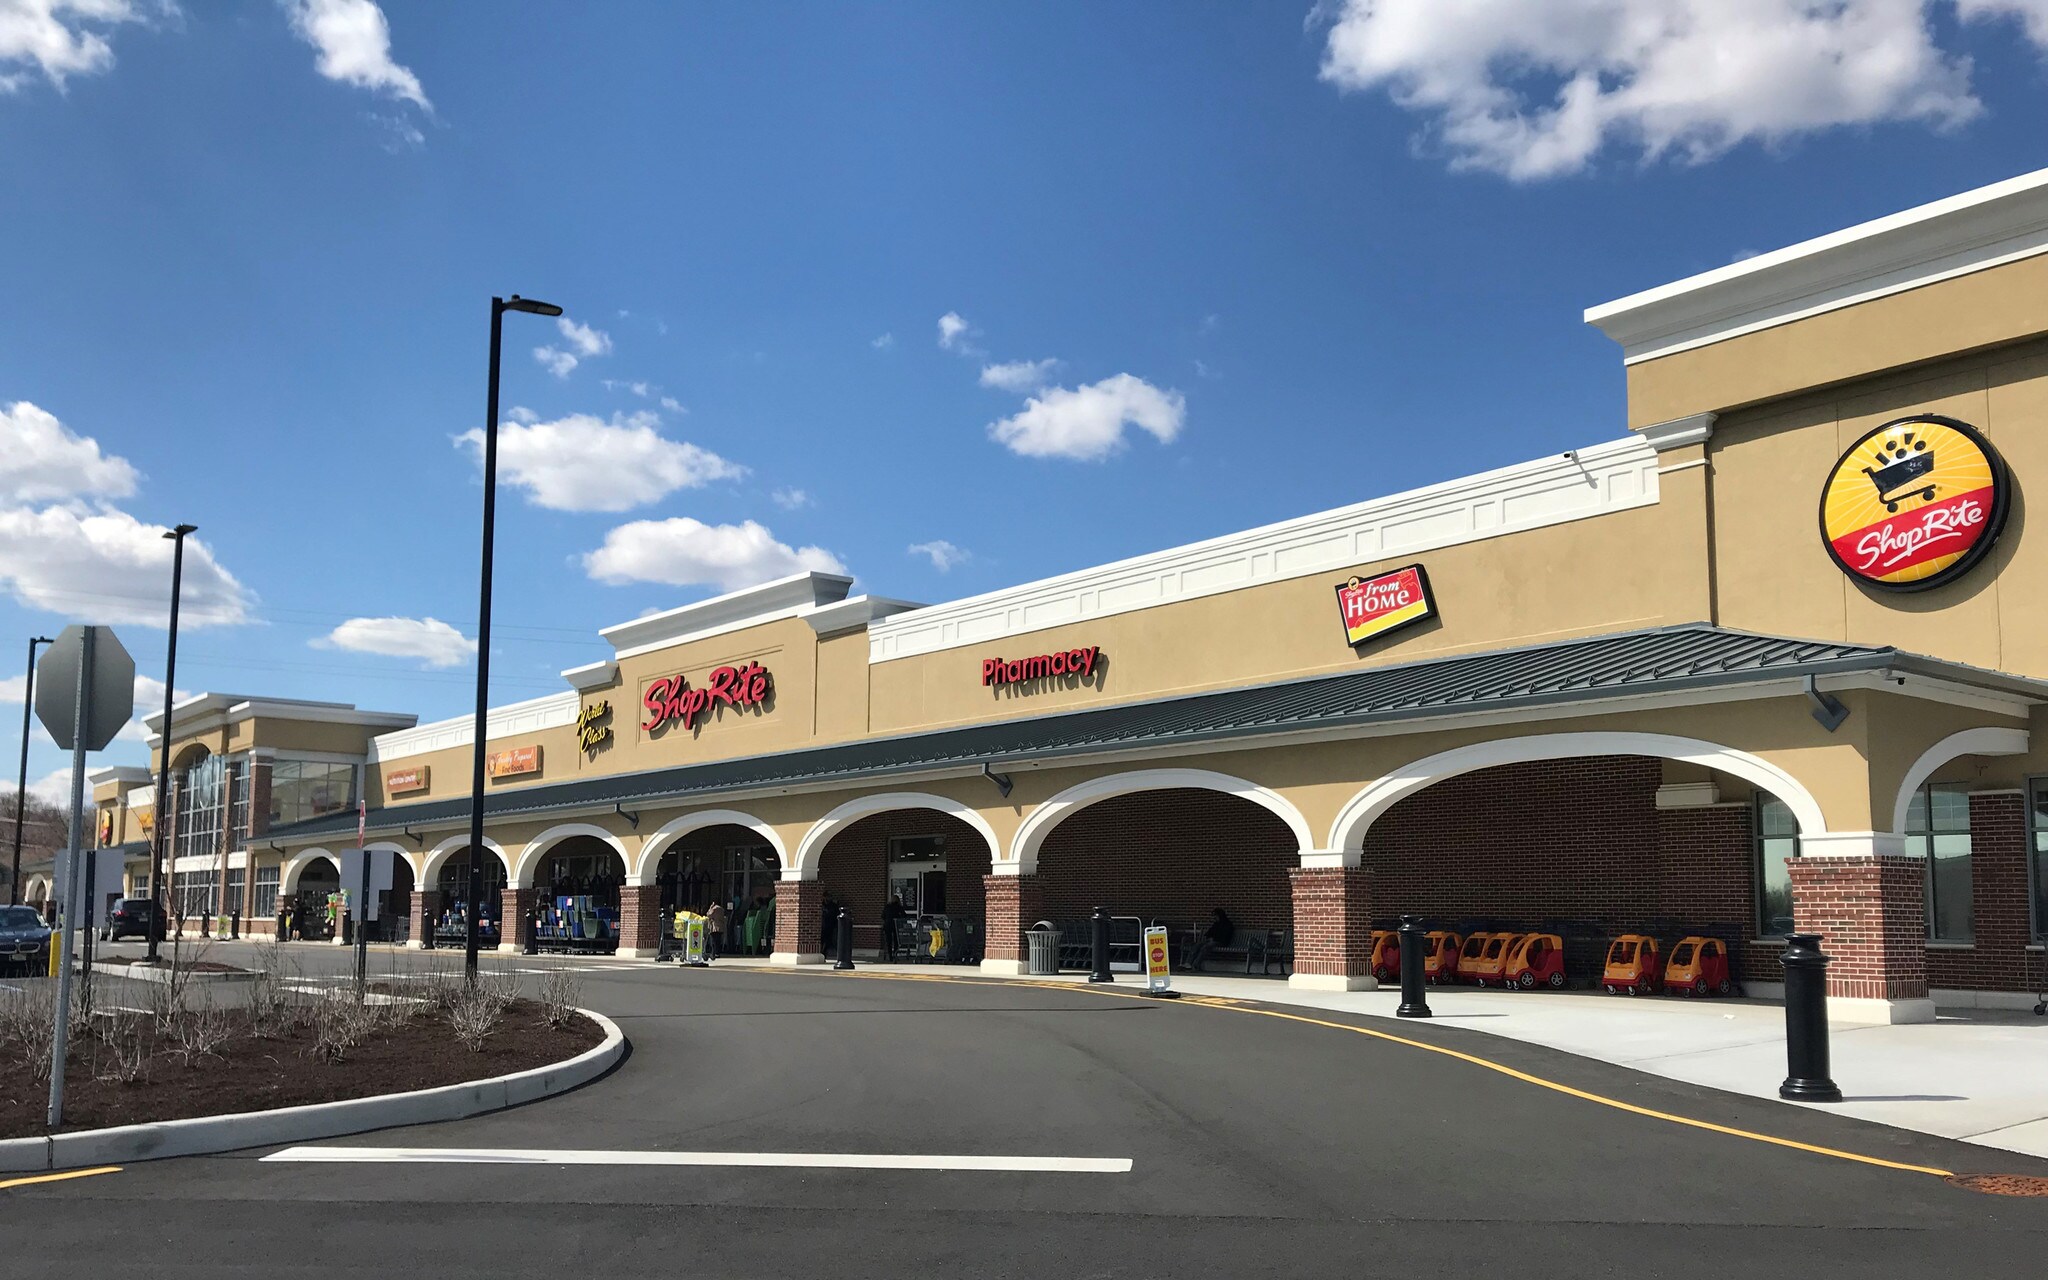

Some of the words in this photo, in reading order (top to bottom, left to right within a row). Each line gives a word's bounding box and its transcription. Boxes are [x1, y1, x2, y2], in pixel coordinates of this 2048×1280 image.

[1857, 501, 1983, 569] ShopRite
[1364, 581, 1399, 598] from
[982, 646, 1098, 686] Pharmacy
[641, 660, 767, 731] ShopRite
[580, 726, 607, 753] Class
